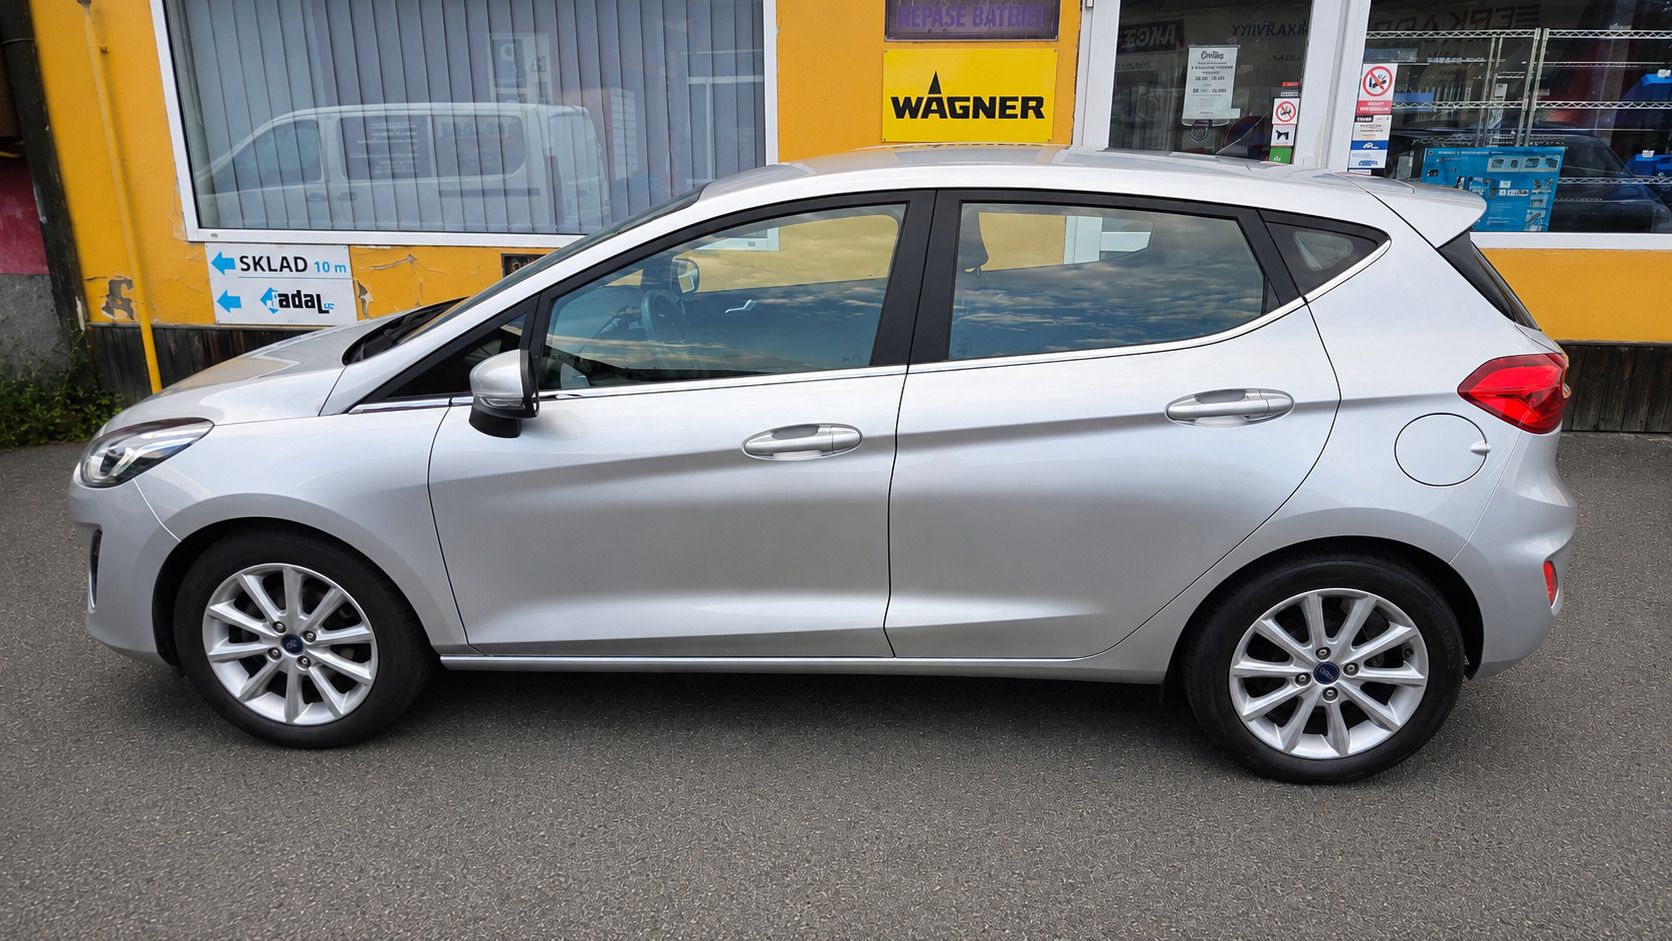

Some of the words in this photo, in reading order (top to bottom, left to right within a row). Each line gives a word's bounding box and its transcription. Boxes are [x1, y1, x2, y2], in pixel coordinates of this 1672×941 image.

[890, 78, 1045, 119] WAGNER
[240, 255, 308, 272] SKLAD
[314, 261, 331, 273] 10
[334, 264, 347, 273] m
